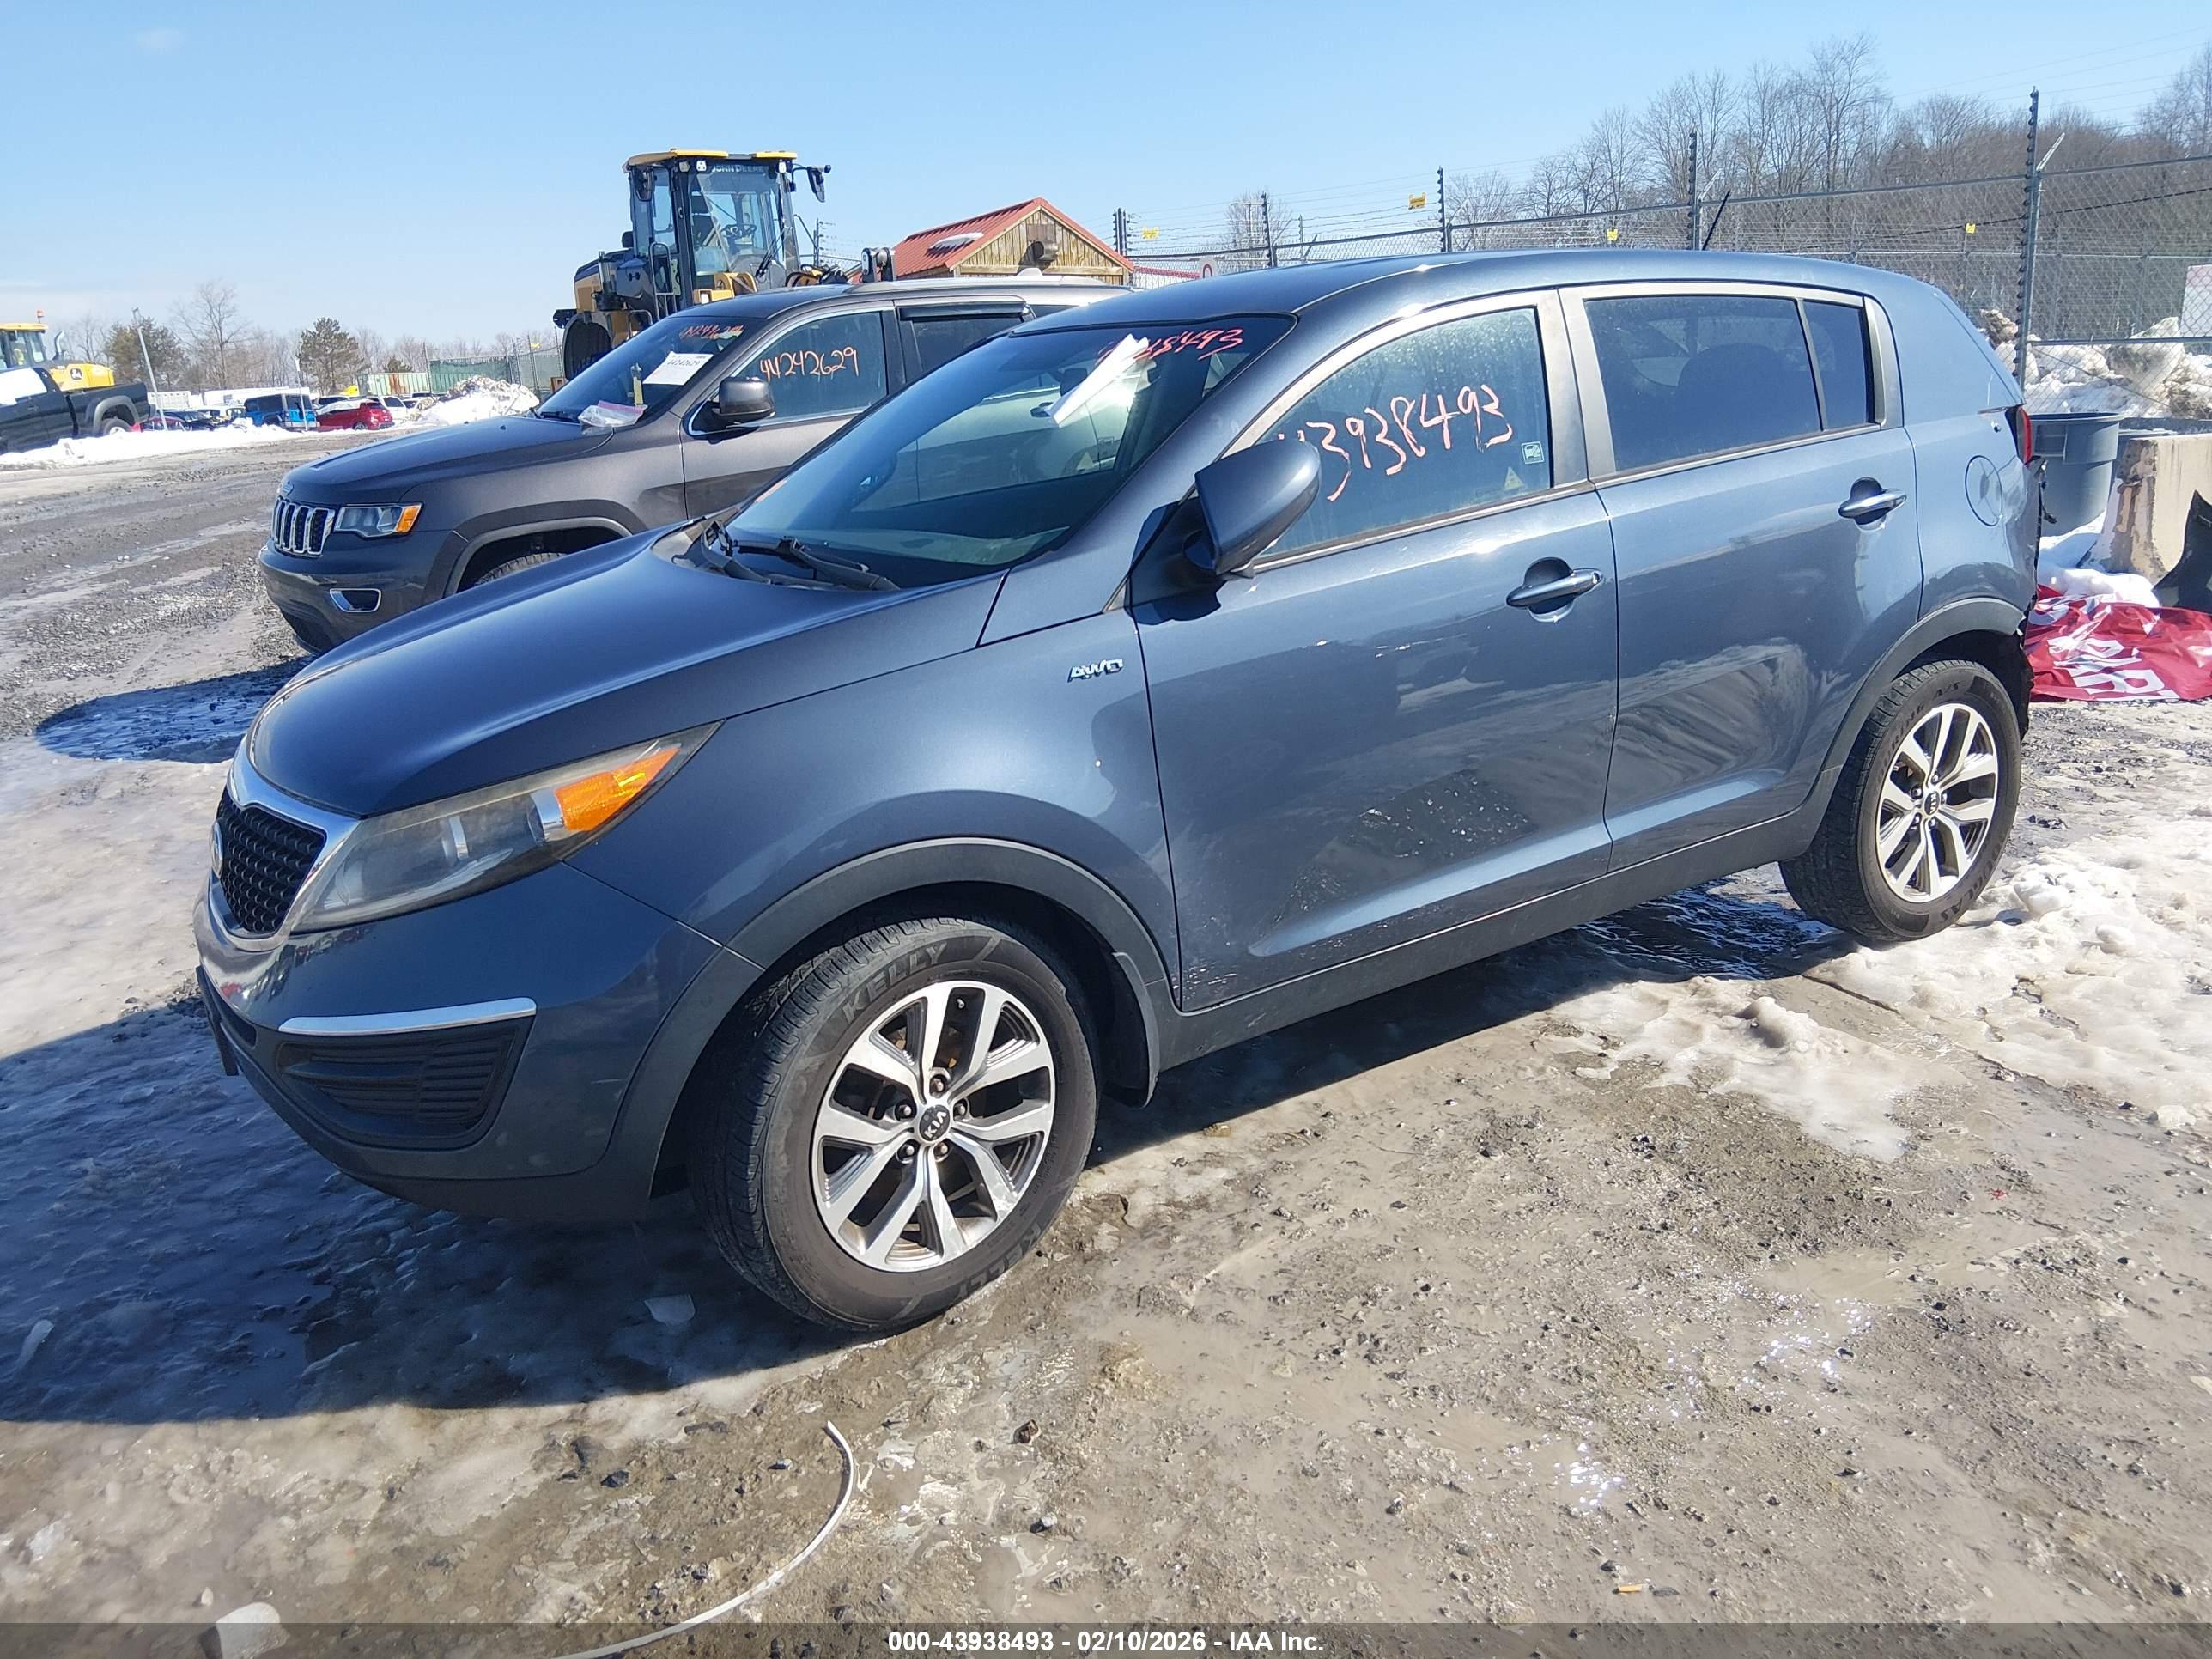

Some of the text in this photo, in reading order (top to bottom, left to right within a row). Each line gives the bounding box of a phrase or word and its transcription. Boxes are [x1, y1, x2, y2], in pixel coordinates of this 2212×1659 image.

[711, 164, 734, 173] JOHN
[1278, 385, 1512, 501] 3938493
[842, 943, 947, 1024] KELLY
[924, 1111, 947, 1139] KIA
